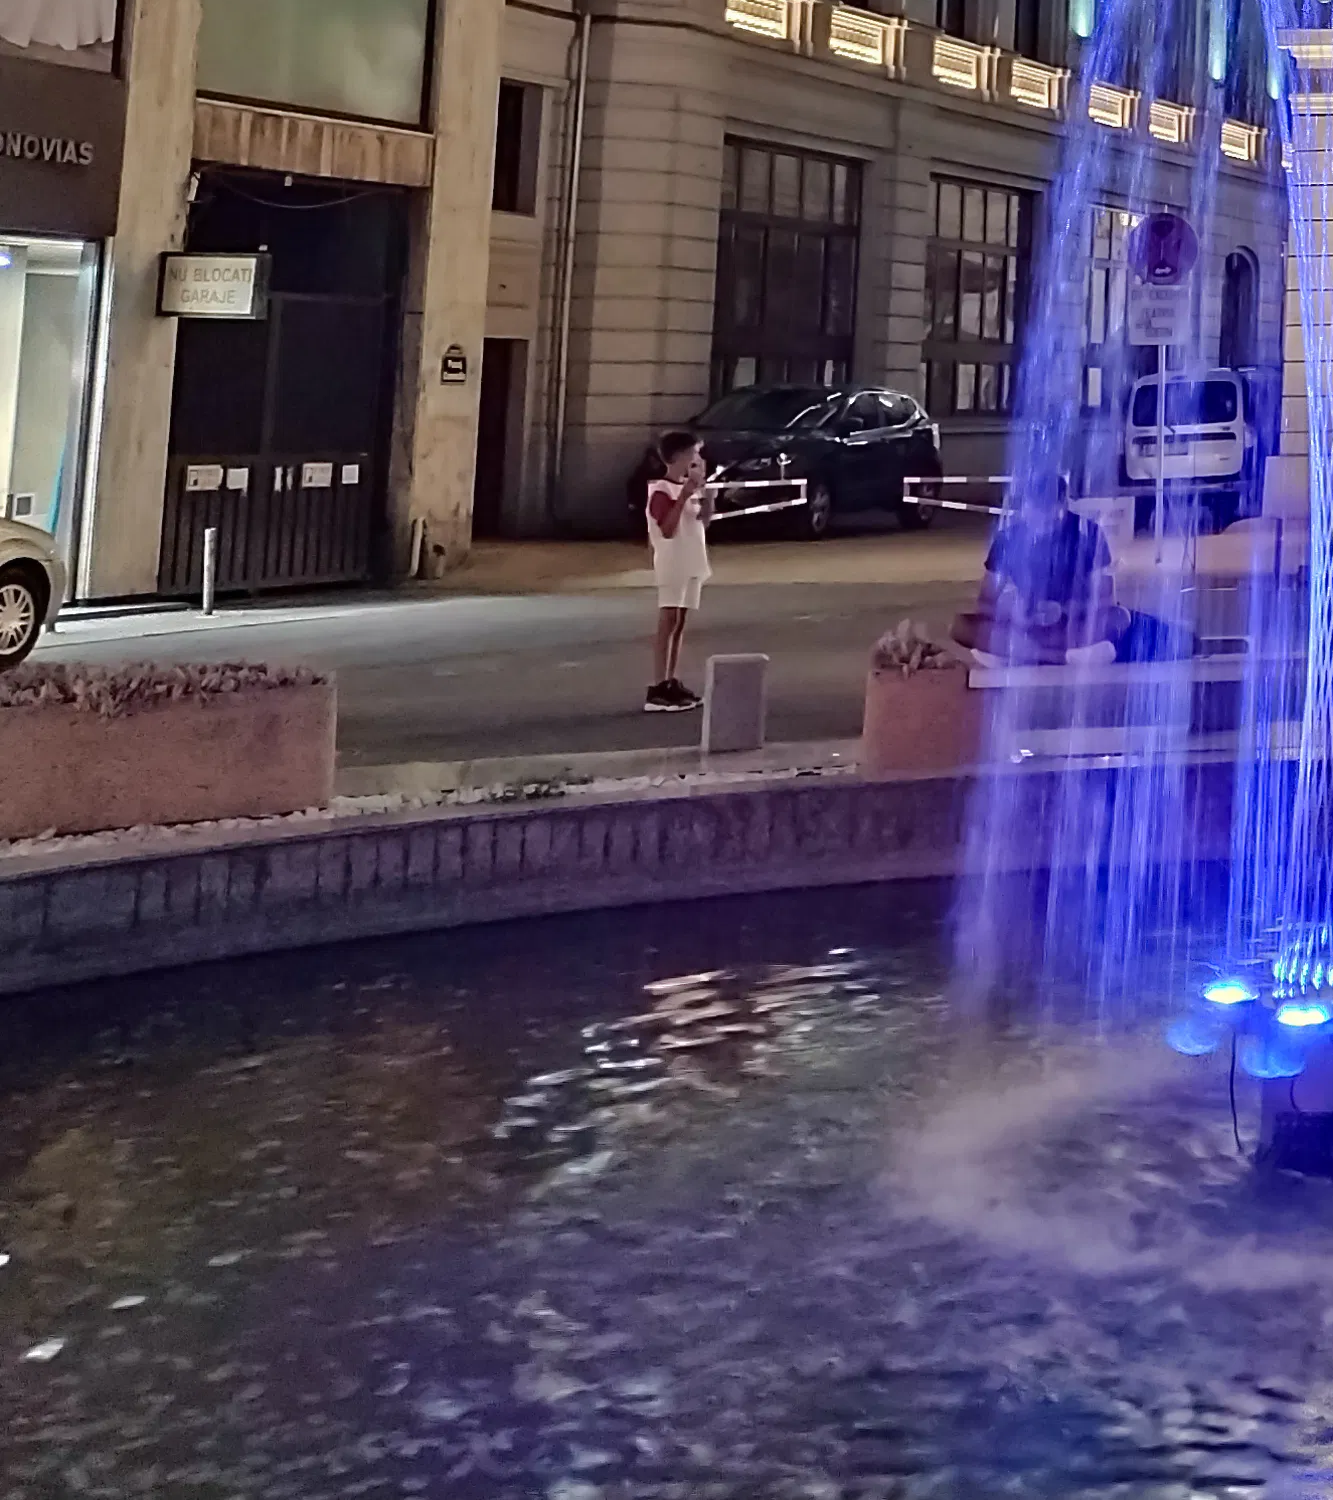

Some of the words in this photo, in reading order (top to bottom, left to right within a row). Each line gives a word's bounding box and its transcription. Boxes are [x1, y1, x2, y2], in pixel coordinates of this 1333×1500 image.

[0, 131, 95, 165] NOVIAS
[168, 266, 187, 282] NU
[181, 288, 236, 304] GARAJE
